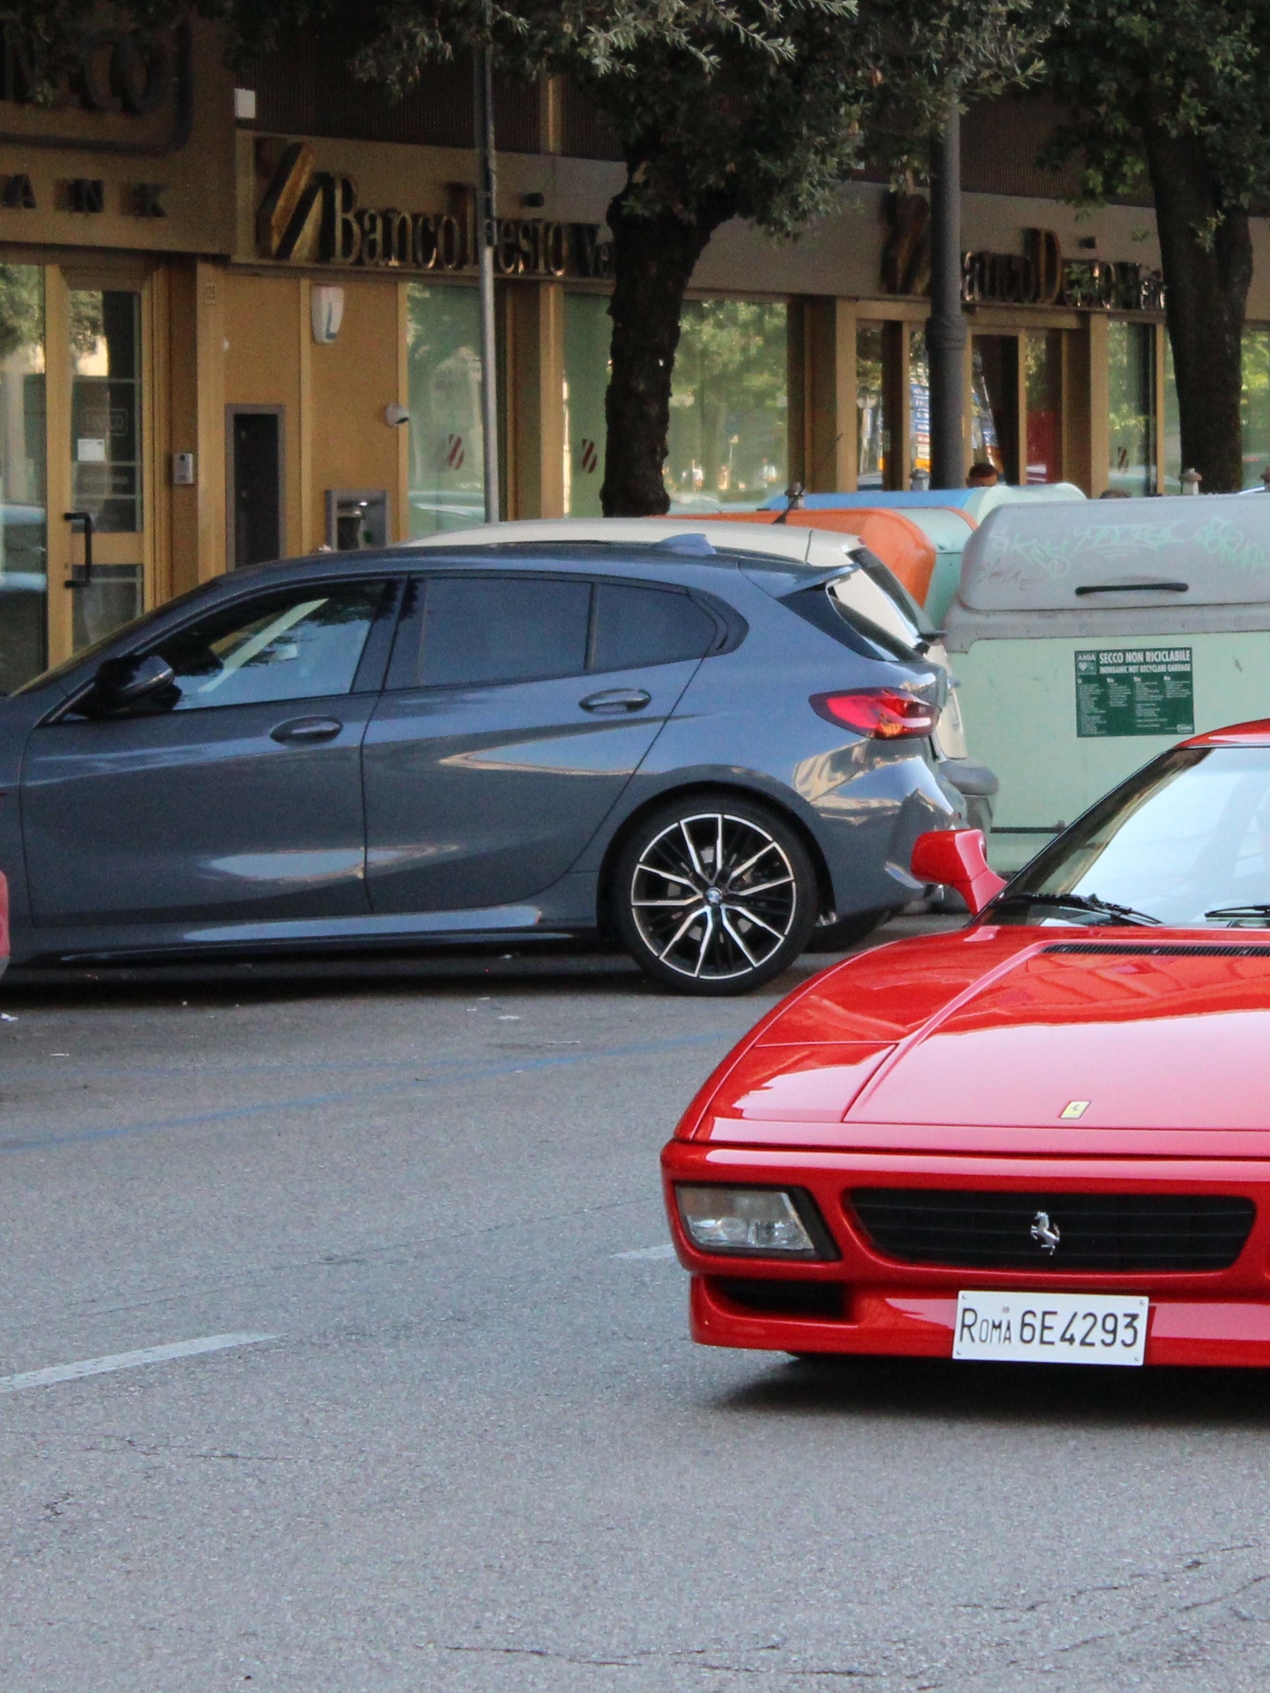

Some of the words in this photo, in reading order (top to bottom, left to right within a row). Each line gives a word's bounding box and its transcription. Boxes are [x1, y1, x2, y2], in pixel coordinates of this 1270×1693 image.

[1099, 652, 1124, 665] SECCO
[1125, 651, 1144, 664] NON
[1145, 650, 1191, 663] RICICLABILE
[1020, 1309, 1140, 1348] 6E4293
